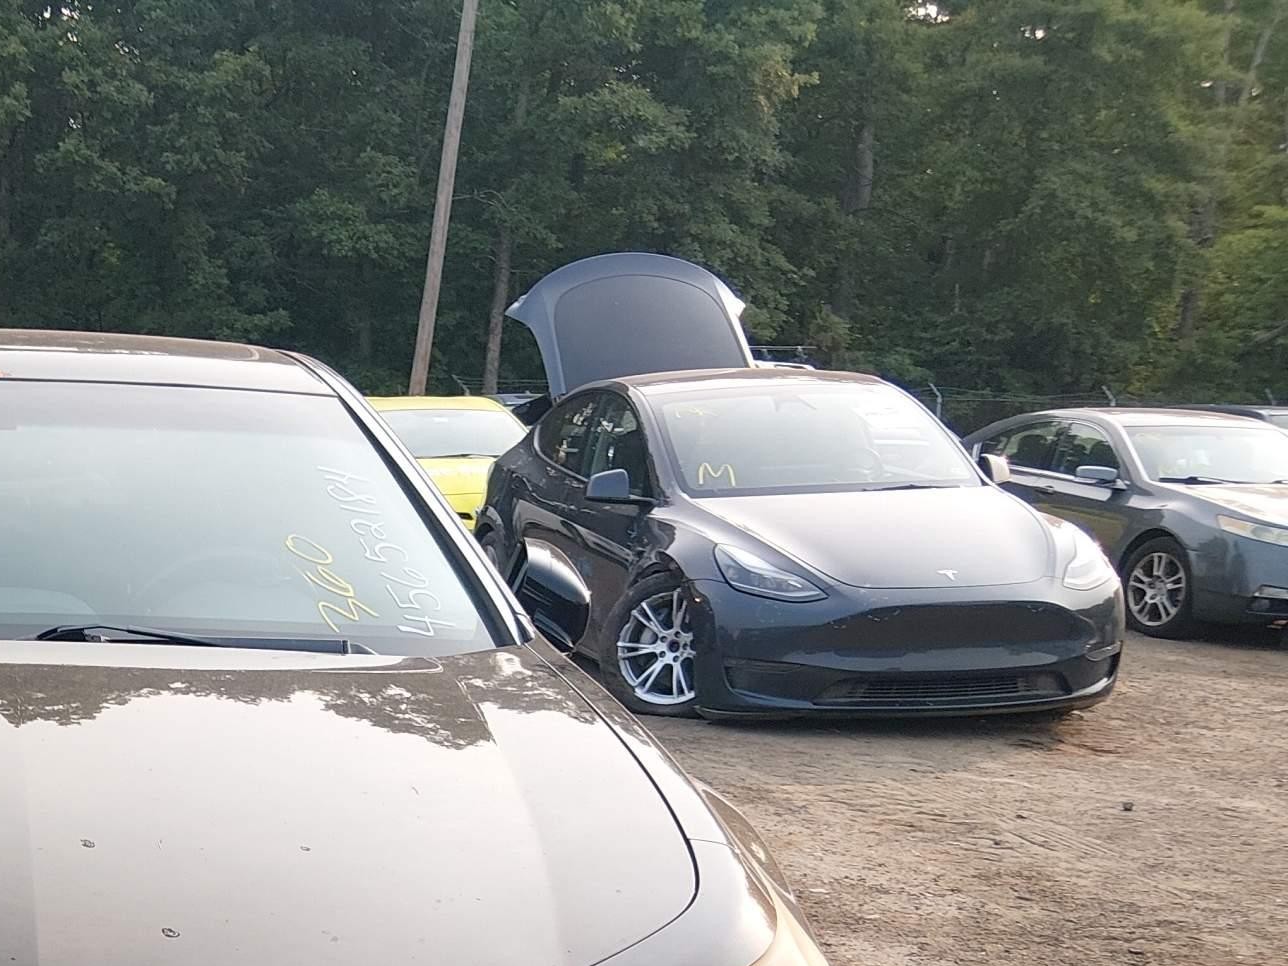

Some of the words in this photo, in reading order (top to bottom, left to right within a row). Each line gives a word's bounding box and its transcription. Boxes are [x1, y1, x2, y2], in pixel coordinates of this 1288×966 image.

[697, 462, 737, 488] M
[285, 533, 380, 633] 360
[316, 464, 457, 638] 45652184
